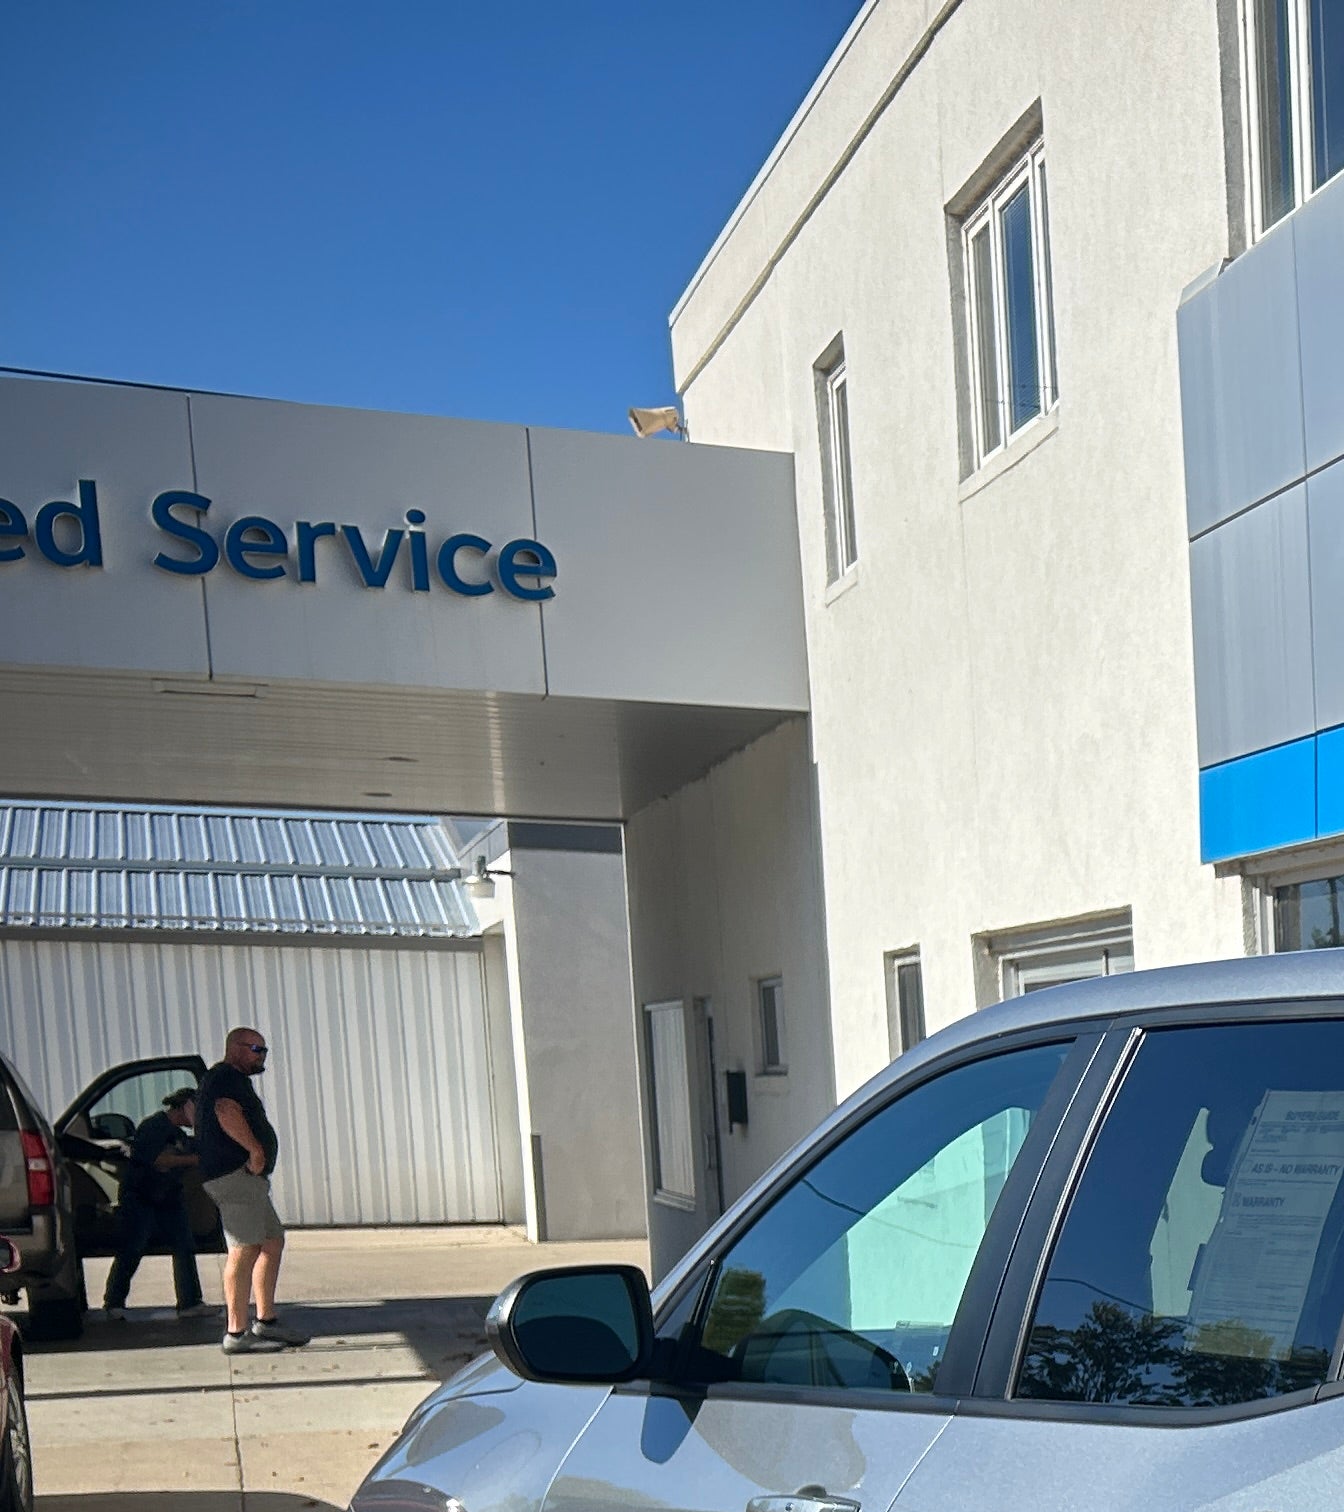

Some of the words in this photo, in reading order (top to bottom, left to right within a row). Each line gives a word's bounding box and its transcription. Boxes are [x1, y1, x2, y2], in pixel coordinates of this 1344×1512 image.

[152, 490, 558, 600] Service
[1294, 1164, 1341, 1175] WARRANTY
[1242, 1197, 1285, 1208] WARRANTY
